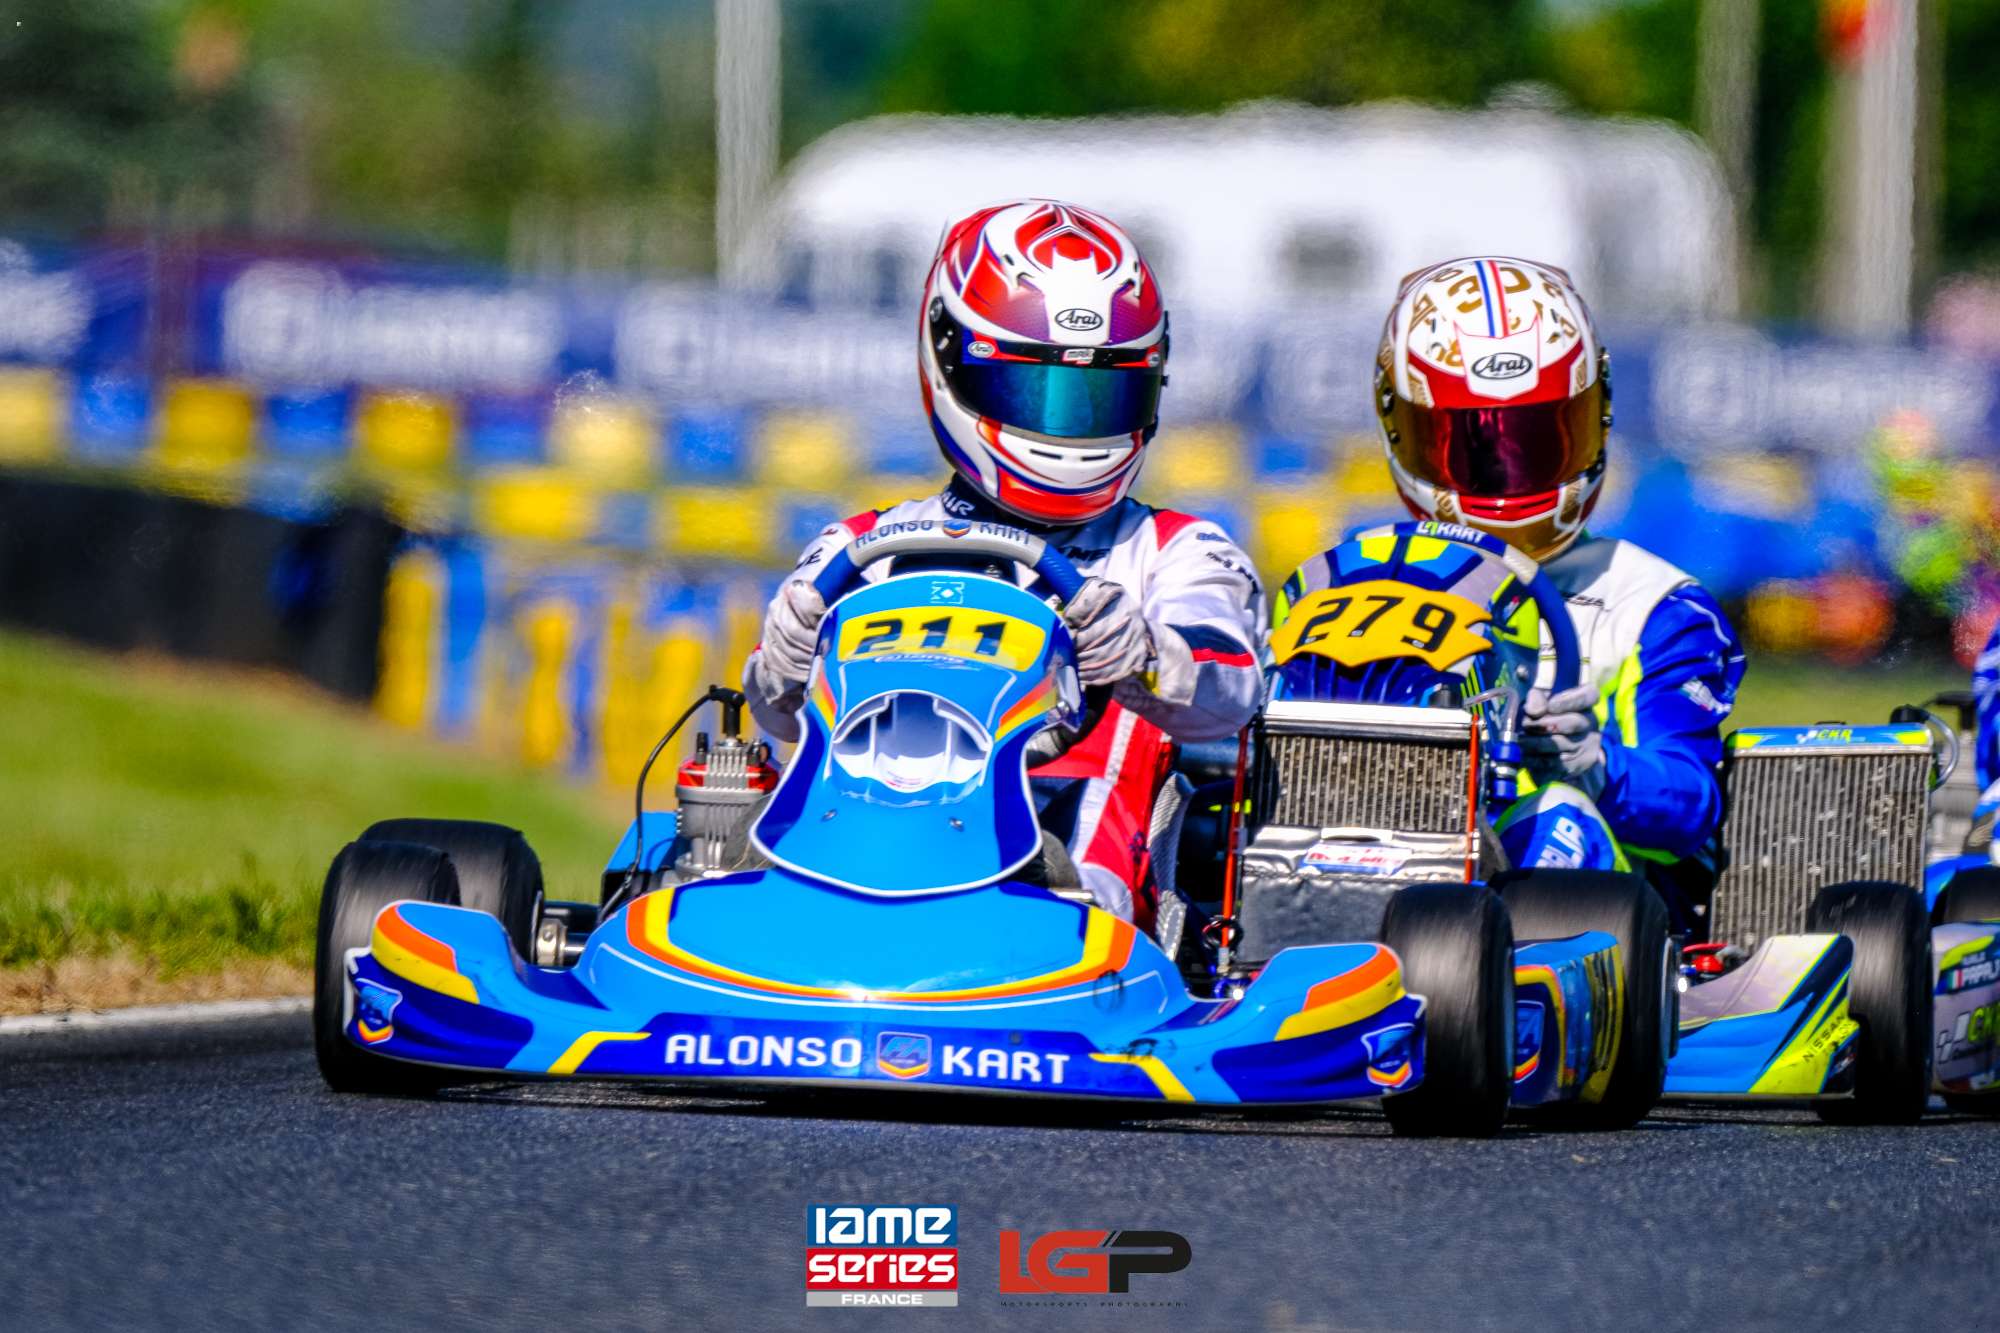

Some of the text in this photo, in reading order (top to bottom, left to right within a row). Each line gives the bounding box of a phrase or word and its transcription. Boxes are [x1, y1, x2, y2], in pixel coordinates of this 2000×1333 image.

[1058, 309, 1099, 325] Arai
[1475, 354, 1527, 372] Arai
[855, 519, 1032, 549] ALONSO KART
[854, 616, 1008, 656] 211
[1292, 595, 1456, 653] 279
[1802, 1013, 1846, 1063] NISSAN
[664, 1033, 1070, 1084] ALONSO KART
